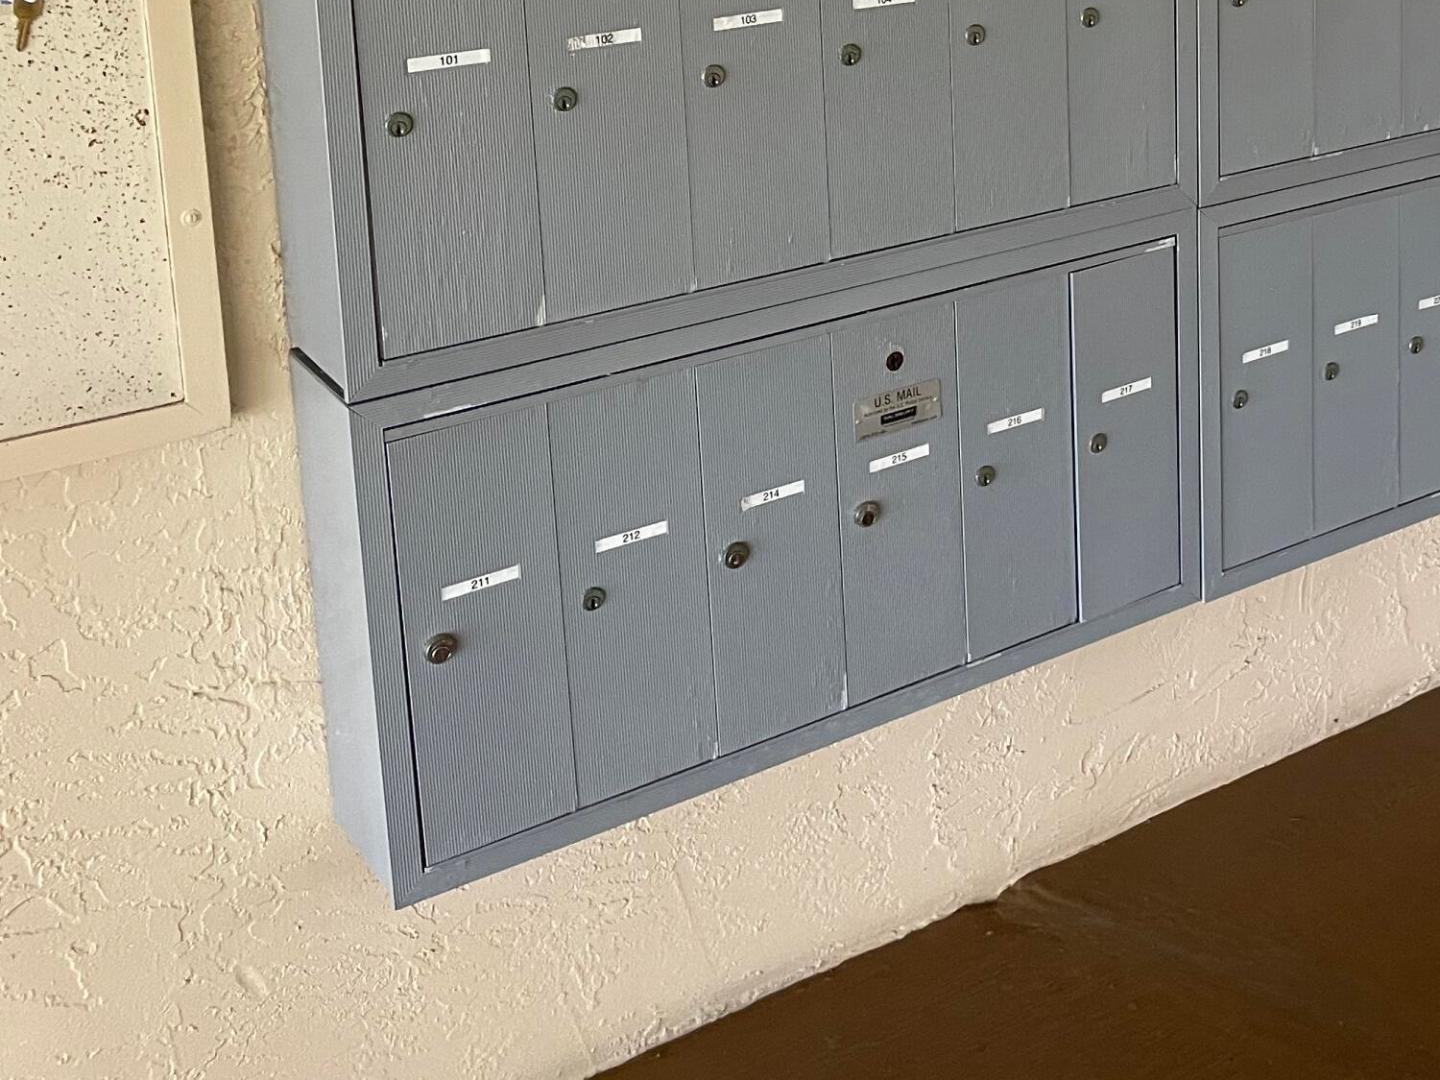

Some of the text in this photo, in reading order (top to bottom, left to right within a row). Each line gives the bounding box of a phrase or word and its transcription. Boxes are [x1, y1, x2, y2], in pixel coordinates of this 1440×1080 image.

[740, 14, 757, 25] 103
[595, 33, 614, 45] 102
[440, 54, 459, 66] 101
[1119, 384, 1133, 396] 217
[874, 394, 891, 408] U.S.
[896, 386, 922, 401] MAIL
[891, 452, 907, 465] 215
[762, 489, 780, 502] 214
[622, 530, 641, 544] 212
[471, 576, 490, 590] 211
